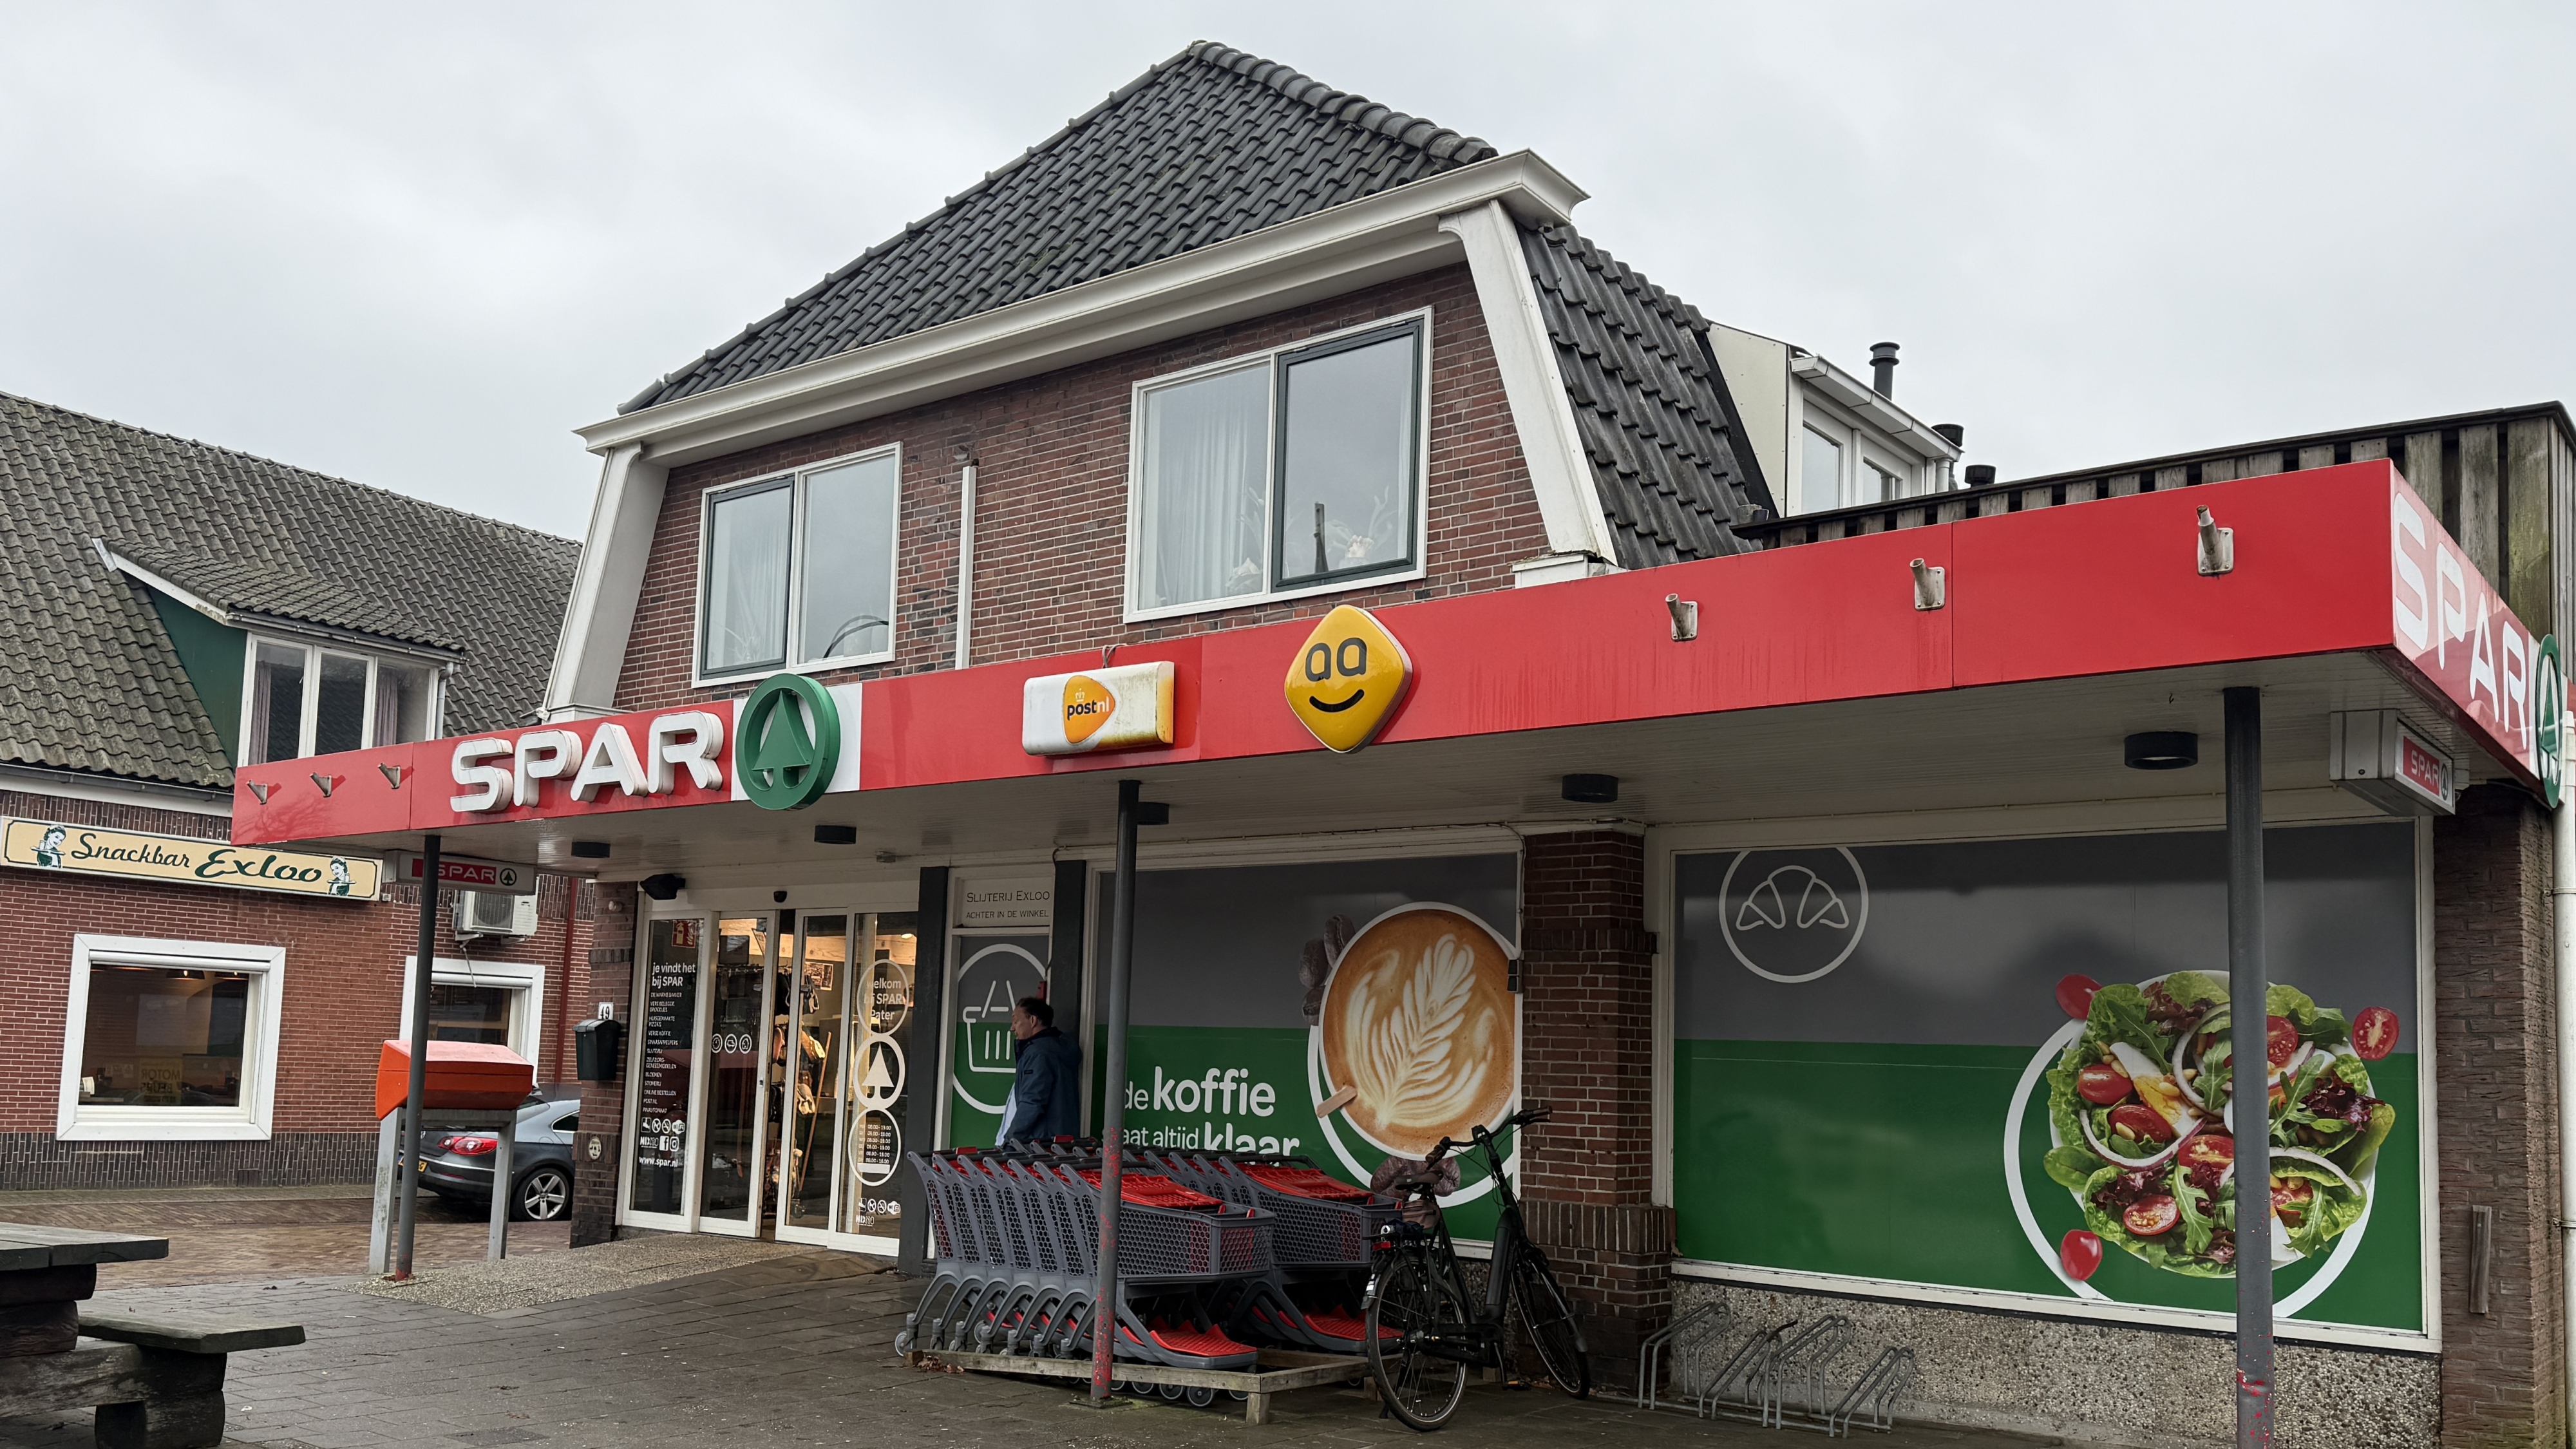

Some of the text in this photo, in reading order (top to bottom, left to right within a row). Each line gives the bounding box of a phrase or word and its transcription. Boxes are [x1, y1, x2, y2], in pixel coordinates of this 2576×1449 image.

[2394, 492, 2527, 750] SPAR
[450, 710, 724, 813] SPAR
[2411, 750, 2439, 788] SPAR
[71, 833, 322, 882] Snackbar Exloo
[967, 891, 1050, 903] SLIJTERIJ EXLOO
[652, 962, 696, 975] je vindt het
[652, 976, 683, 989] bij SPAR
[866, 978, 901, 989] elkom
[876, 993, 904, 1005] SPAR
[600, 1006, 610, 1020] 49
[1125, 1066, 1276, 1117] de koffie
[1153, 1126, 1198, 1150] altijd
[1204, 1122, 1300, 1163] klaar
[639, 1157, 678, 1168] www.spar.nl
